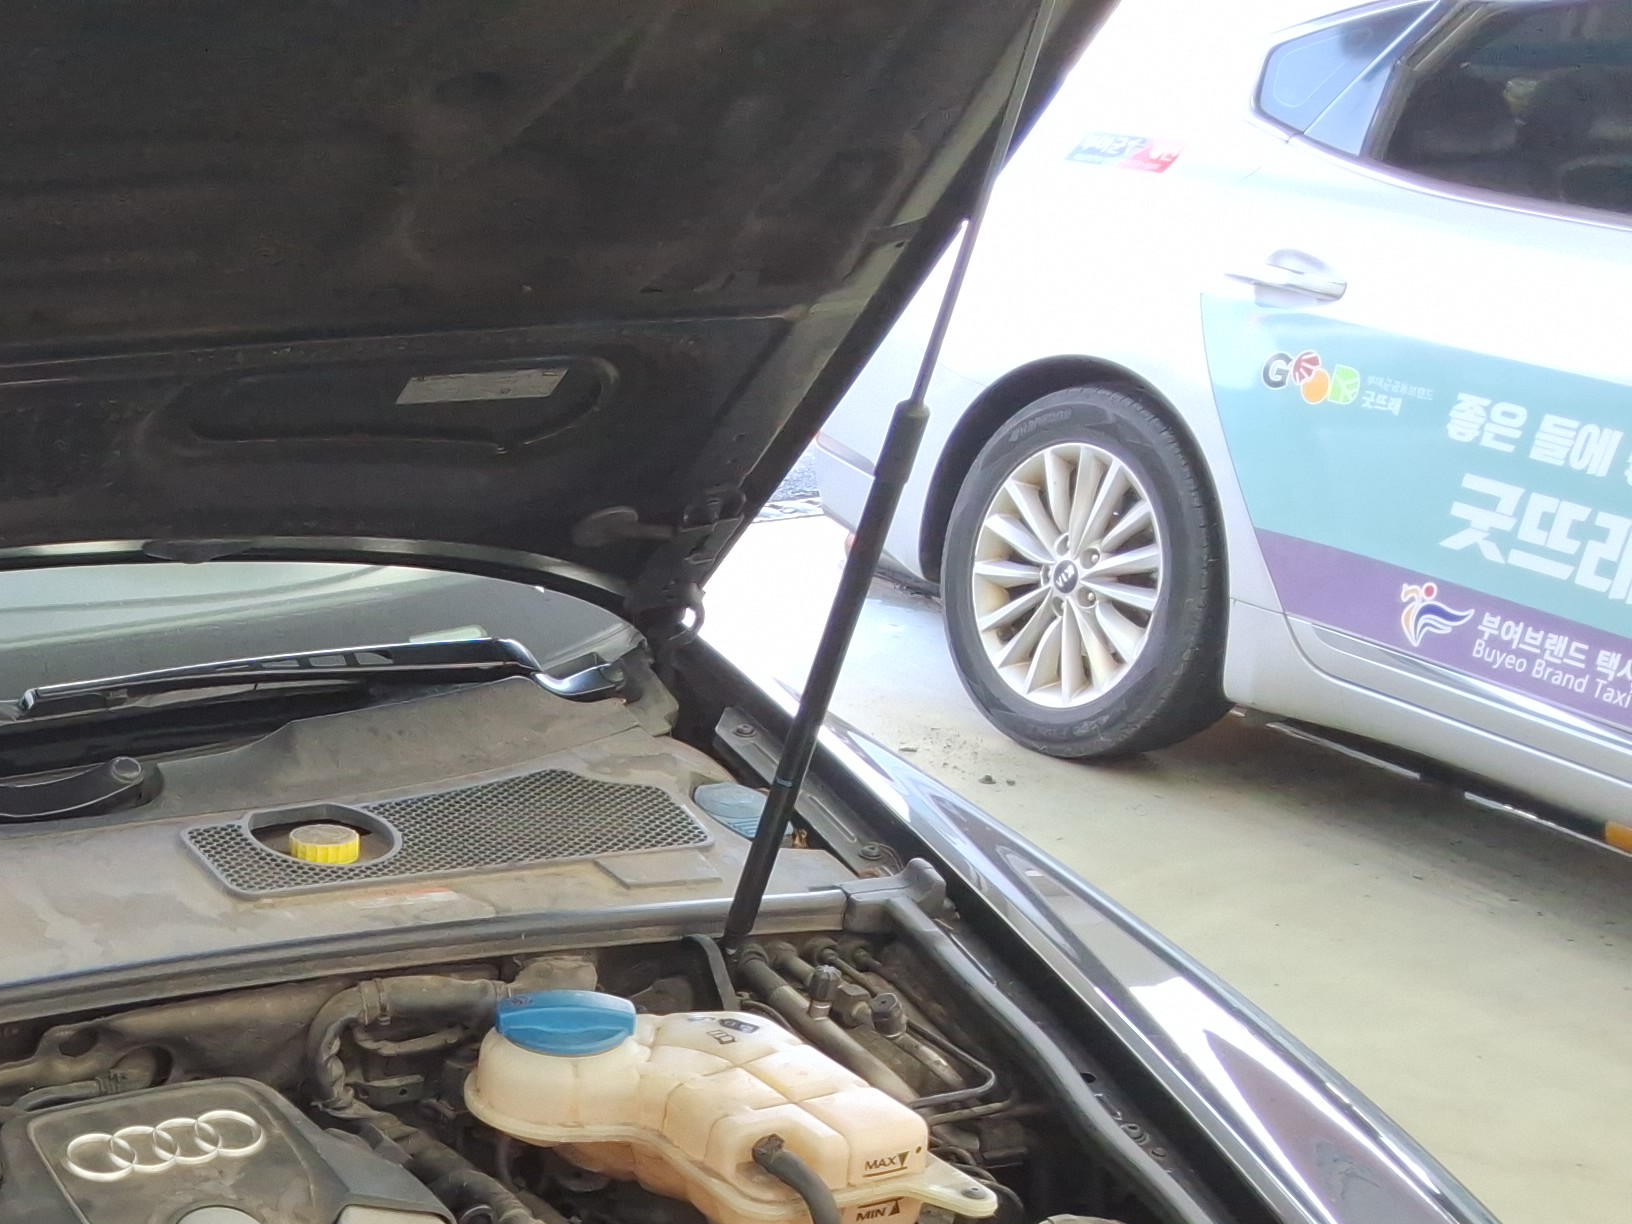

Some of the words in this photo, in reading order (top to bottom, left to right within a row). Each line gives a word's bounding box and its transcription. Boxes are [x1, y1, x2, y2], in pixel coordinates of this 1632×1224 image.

[1361, 390, 1403, 416] 굿뜨래
[1446, 392, 1528, 453] 좋은
[1529, 413, 1625, 477] 들에
[1477, 612, 1589, 669] 부여브랜드
[1472, 638, 1527, 673] Buyeo
[1531, 658, 1590, 694] Brand
[1594, 678, 1632, 708] Taxi
[865, 1155, 897, 1171] MAX
[856, 1207, 887, 1221] MIN
